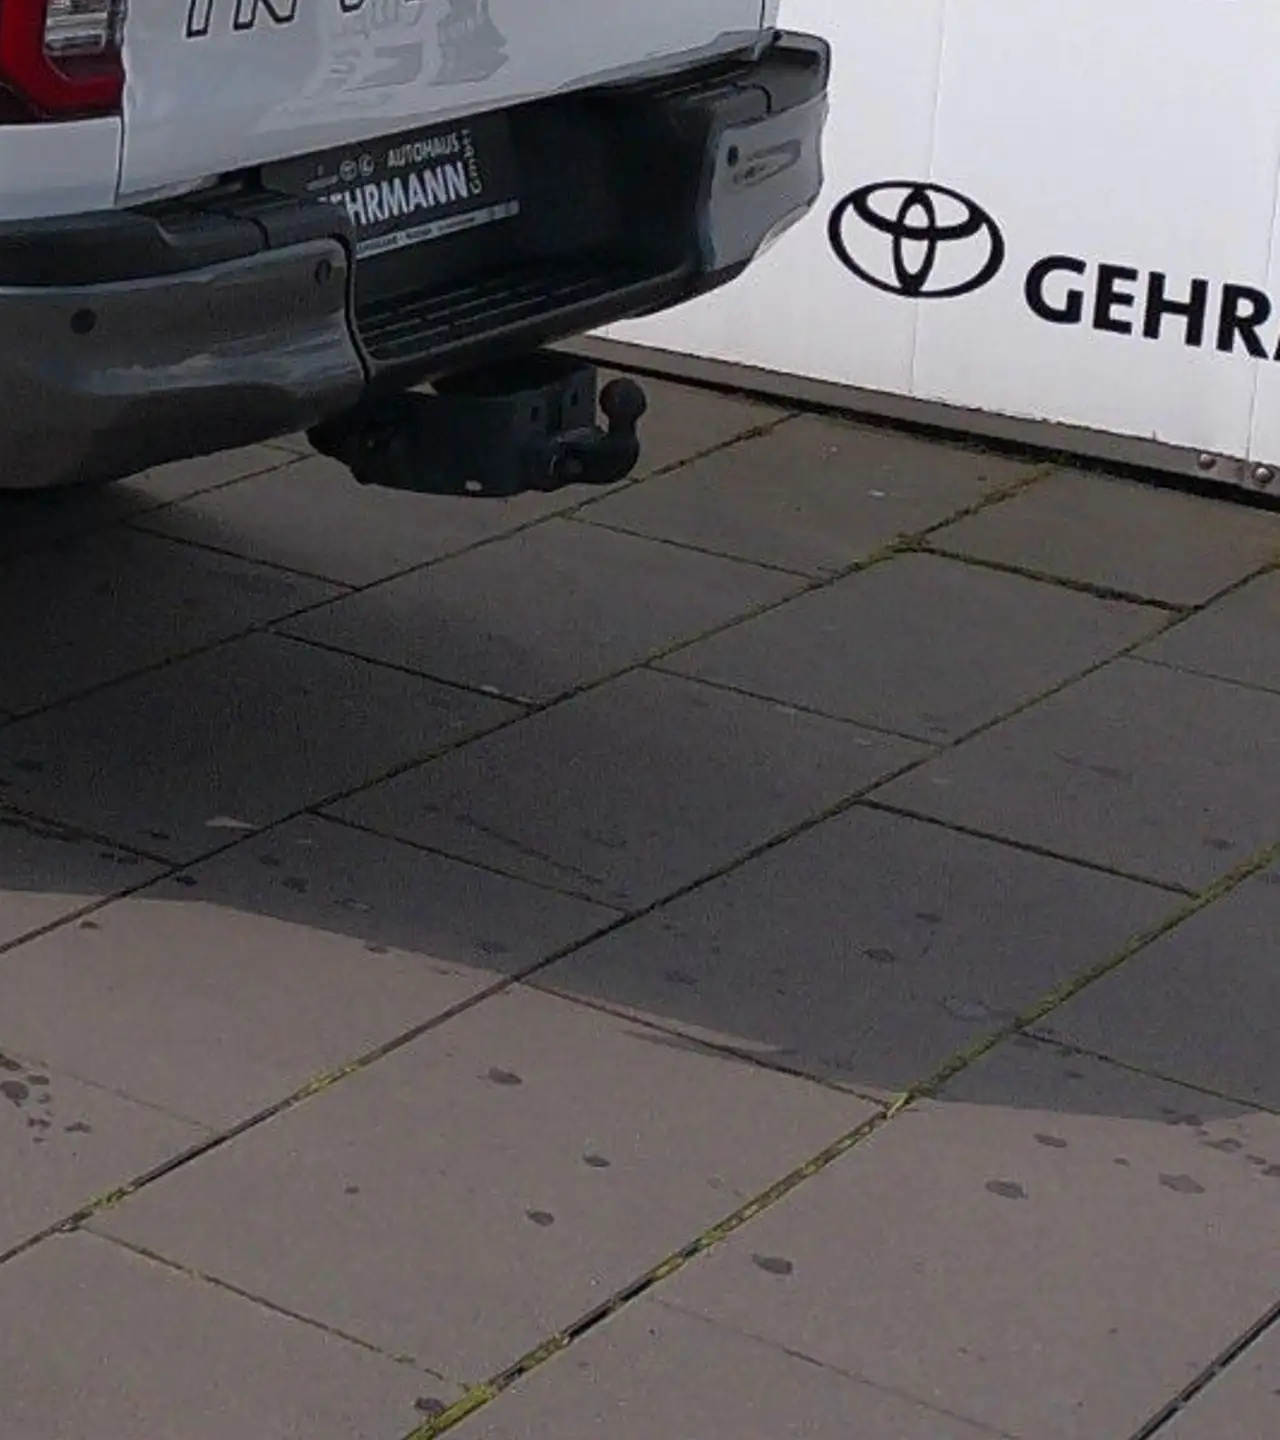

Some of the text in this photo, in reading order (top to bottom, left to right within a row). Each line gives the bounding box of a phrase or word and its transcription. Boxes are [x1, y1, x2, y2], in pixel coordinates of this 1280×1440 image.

[388, 131, 462, 168] AUTOHAUS
[318, 160, 470, 227] HRMANN
[1024, 255, 1280, 362] GEHR
